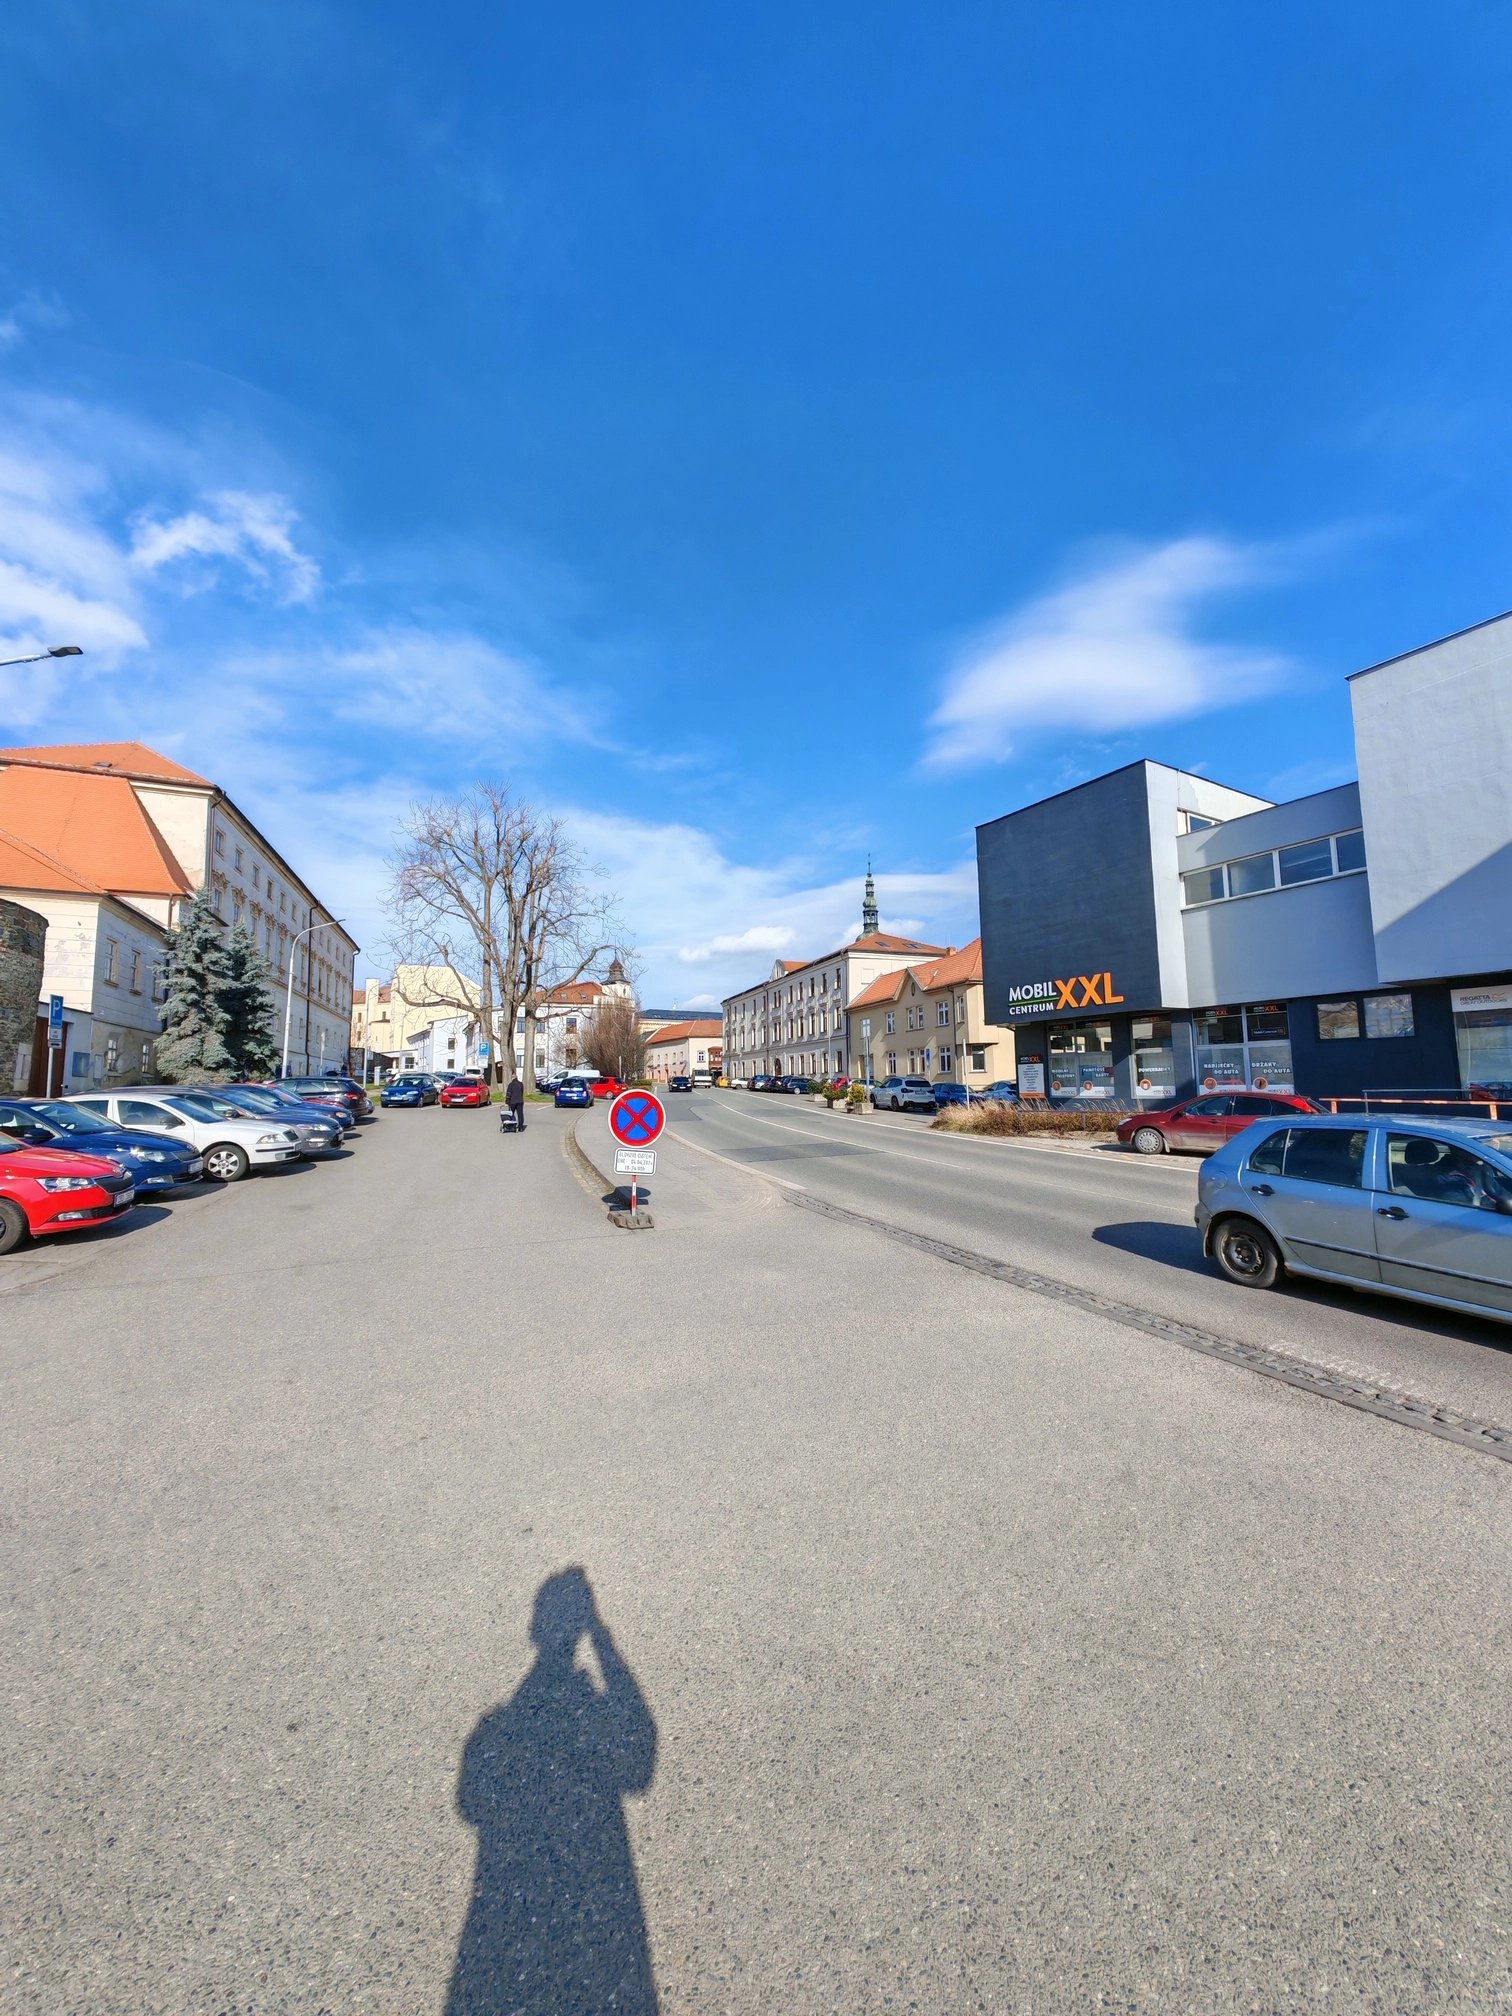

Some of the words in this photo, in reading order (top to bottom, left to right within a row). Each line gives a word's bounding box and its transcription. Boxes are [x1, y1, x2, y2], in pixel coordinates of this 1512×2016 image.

[1009, 981, 1057, 1001] MOBIL
[1055, 972, 1124, 1010] XXL
[1009, 1003, 1054, 1015] CENTRUM
